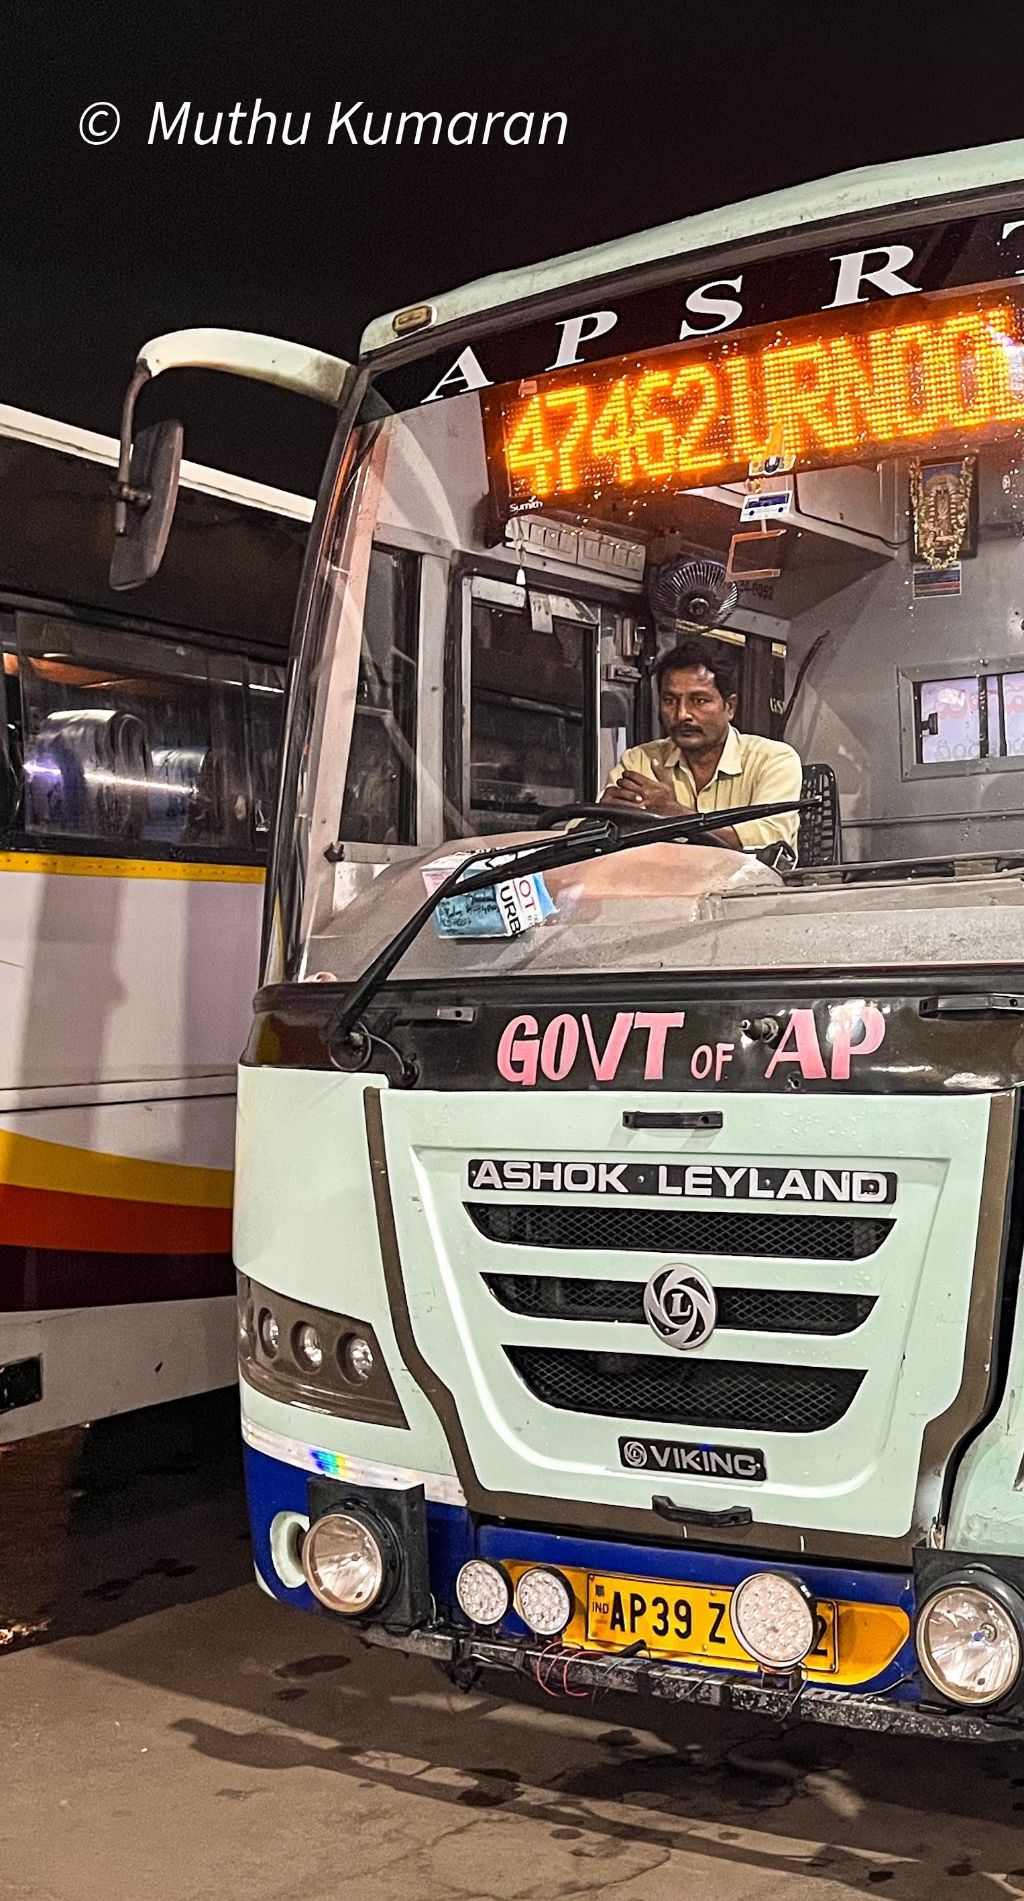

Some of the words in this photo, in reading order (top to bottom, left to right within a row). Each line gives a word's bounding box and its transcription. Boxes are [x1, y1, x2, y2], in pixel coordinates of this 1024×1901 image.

[497, 1009, 686, 1086] GOVT
[690, 1041, 736, 1083] OF
[765, 1002, 887, 1080] AP
[471, 1159, 631, 1194] ASHOK
[657, 1164, 889, 1204] LEYLAND
[649, 1444, 758, 1477] VIKING
[592, 1601, 610, 1615] IND
[609, 1591, 693, 1640] AP39
[708, 1602, 727, 1645] Z
